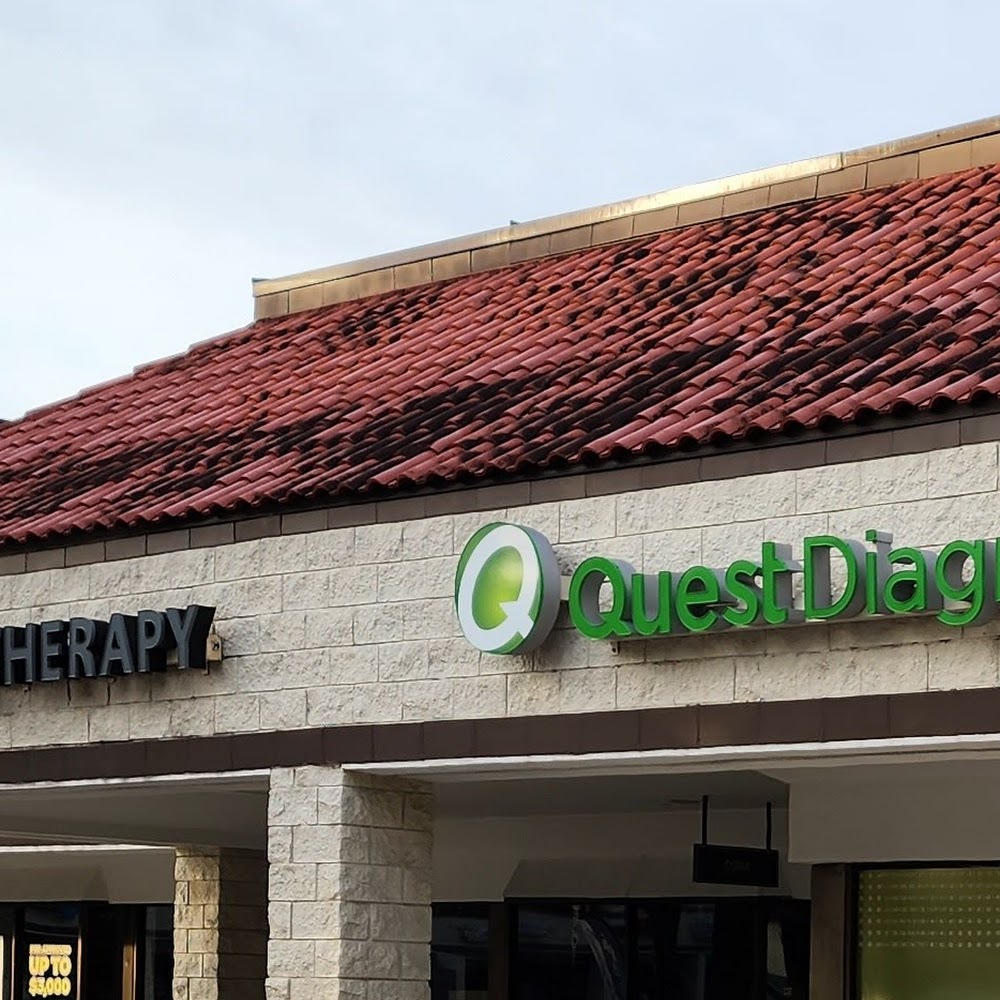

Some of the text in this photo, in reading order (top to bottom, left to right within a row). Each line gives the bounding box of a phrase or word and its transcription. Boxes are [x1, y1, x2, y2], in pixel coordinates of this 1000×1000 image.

[568, 541, 795, 640] Quest
[0, 604, 212, 686] HERAPY
[29, 955, 72, 977] UP TO
